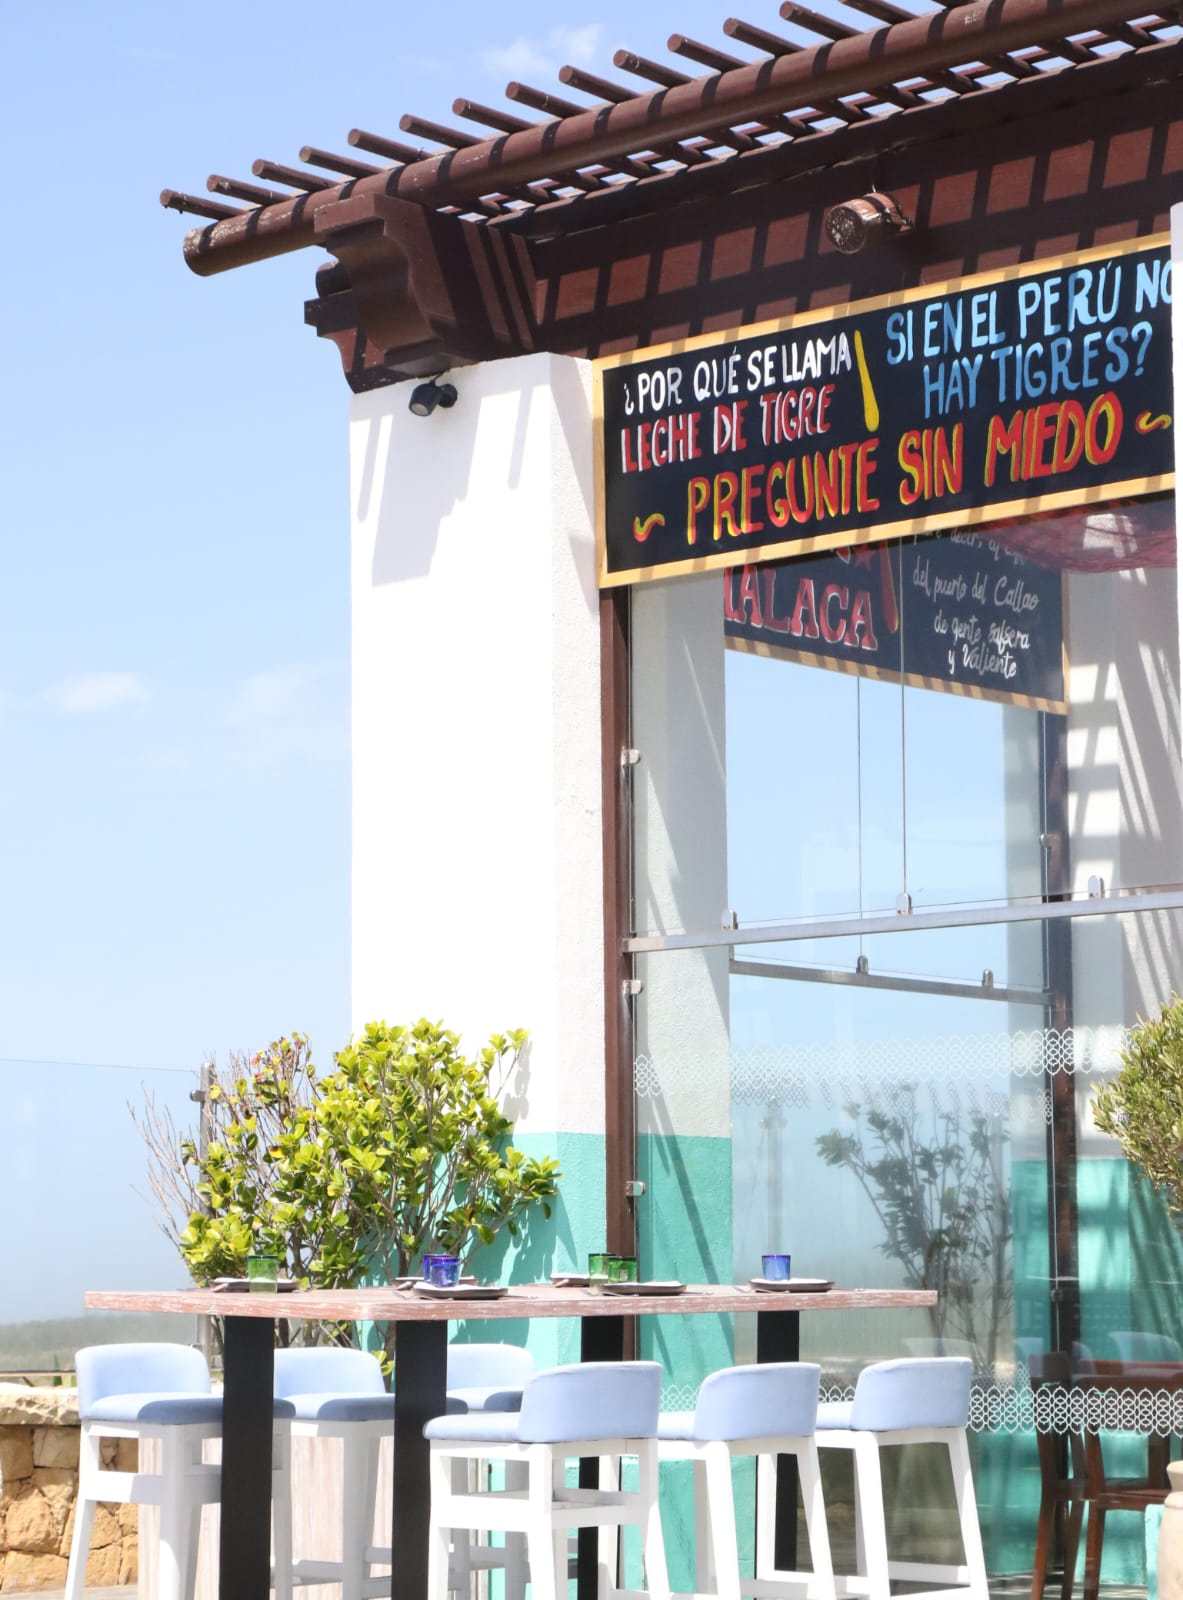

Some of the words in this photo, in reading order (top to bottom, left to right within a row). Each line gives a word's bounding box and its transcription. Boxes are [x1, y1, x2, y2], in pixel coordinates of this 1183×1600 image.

[886, 309, 913, 365] SI
[923, 298, 962, 358] EN
[971, 290, 1006, 348] EL
[1018, 260, 1121, 339] PERÚ
[623, 367, 683, 415] ¿POR
[693, 345, 739, 401] QUÉ
[747, 345, 778, 391] SE
[782, 332, 852, 383] LLAMA
[923, 353, 983, 419] HAY
[991, 321, 1153, 403] TIGRES?
[621, 412, 702, 474] LECHE
[713, 401, 748, 455] DE
[760, 384, 836, 446] TIGRE
[687, 438, 880, 545] PREGUNTE
[898, 422, 963, 505] SIN
[985, 391, 1124, 488] MIEDO
[913, 555, 930, 597] del
[933, 574, 967, 603] puerto
[972, 571, 988, 605] del
[994, 575, 1040, 613] Callao
[934, 608, 949, 634] de
[951, 614, 982, 646] gente
[948, 650, 955, 675] y
